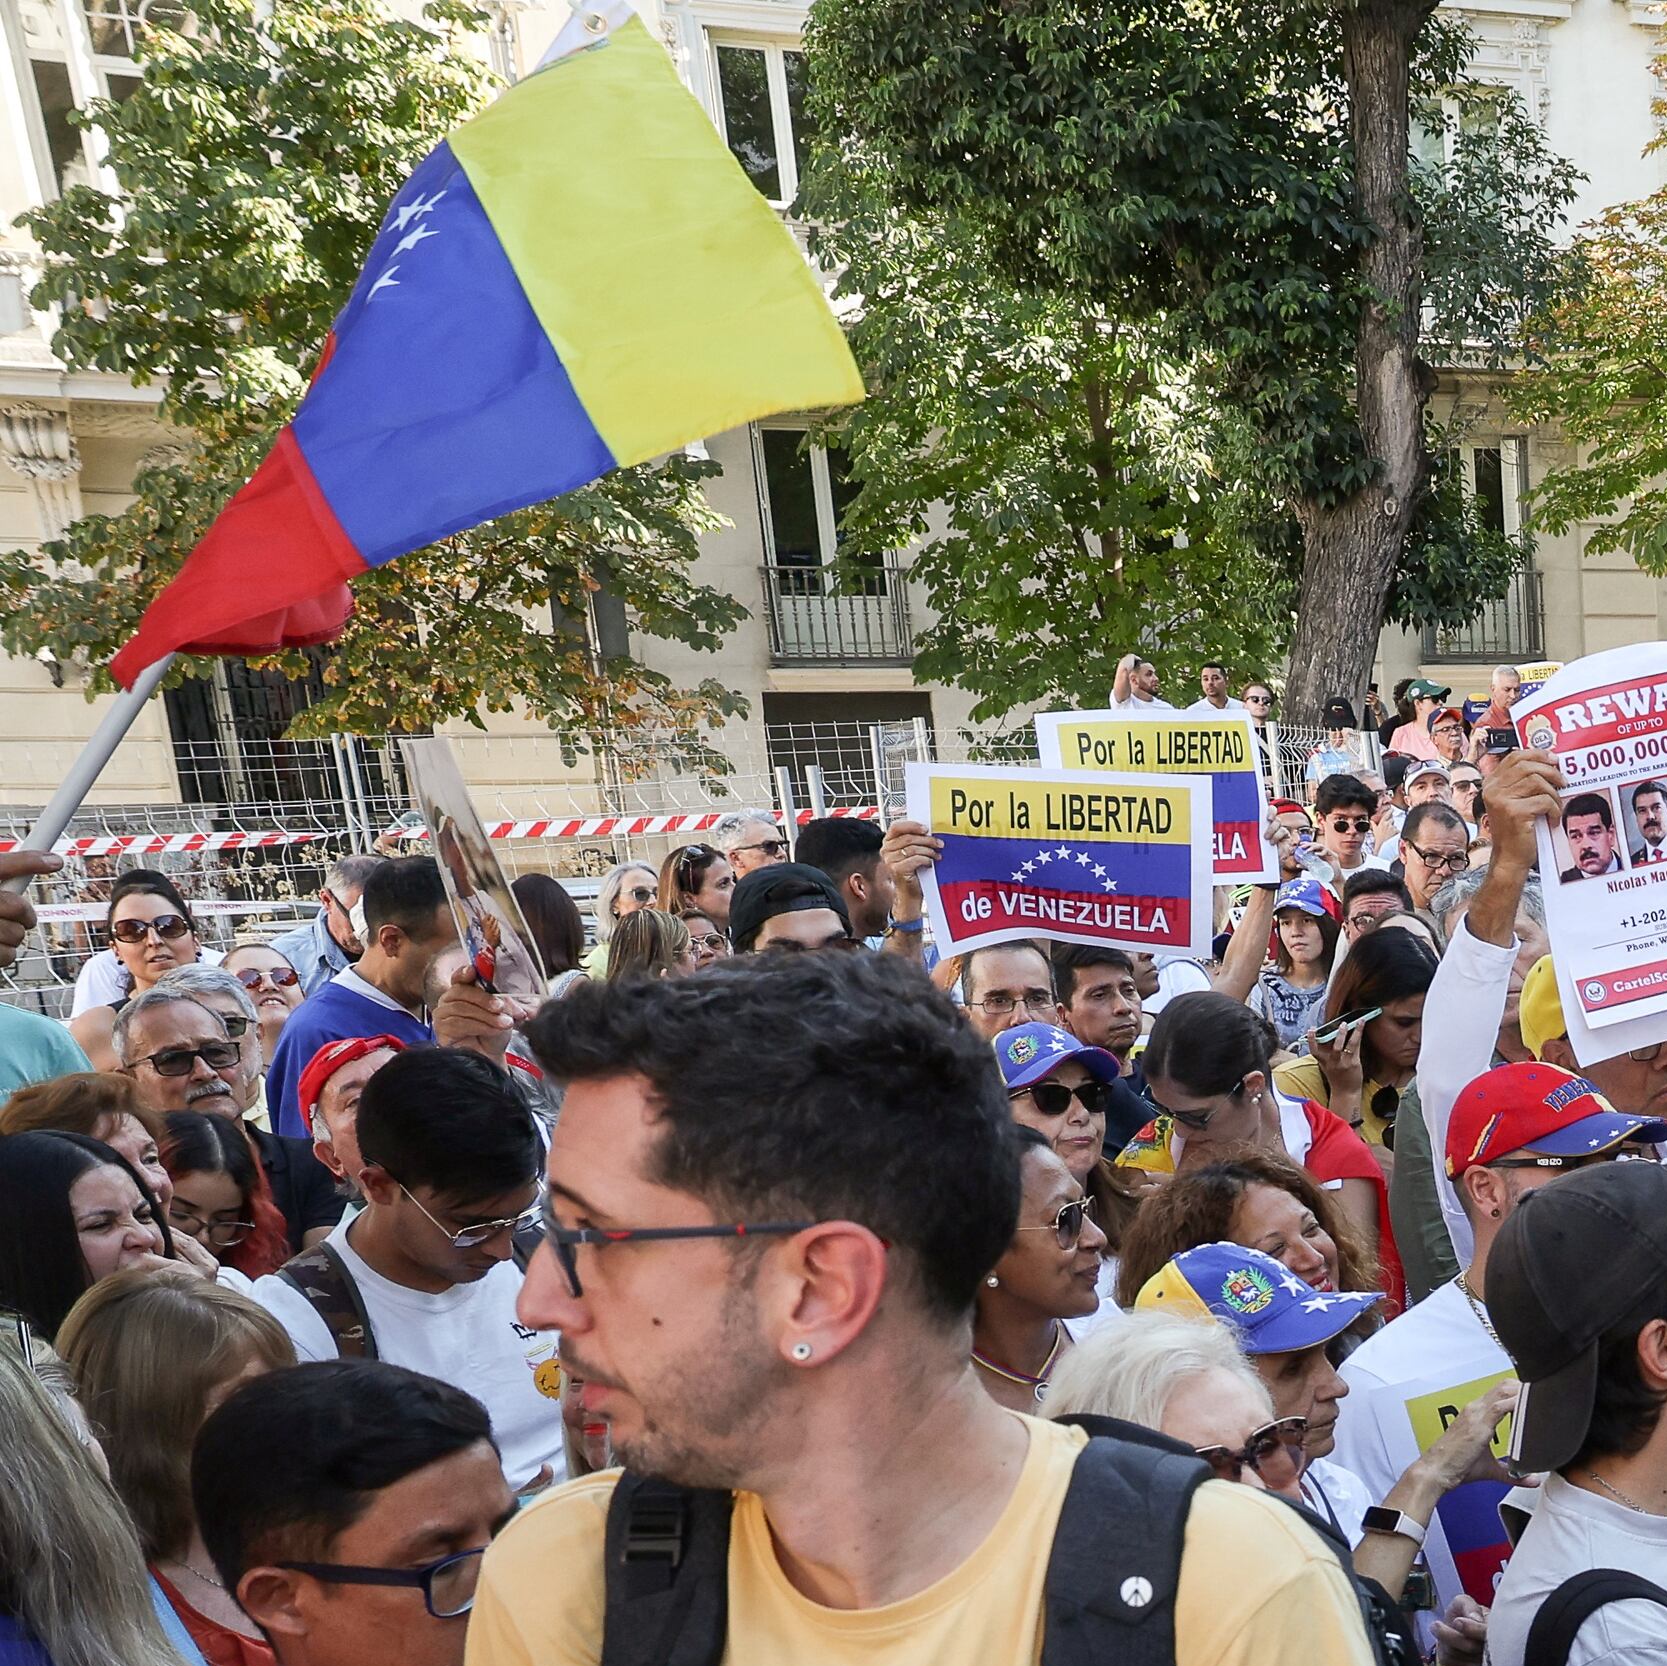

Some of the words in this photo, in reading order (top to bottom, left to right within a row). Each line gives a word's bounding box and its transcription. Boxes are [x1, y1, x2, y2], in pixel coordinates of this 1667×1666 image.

[1617, 723, 1631, 734] OF
[1633, 721, 1648, 731] UP
[1649, 717, 1664, 728] TO
[1077, 732, 1116, 765] Por
[1127, 731, 1145, 765] la
[1156, 730, 1244, 764] LIBERTAD
[1599, 771, 1629, 782] LEADING
[950, 789, 995, 829] Por
[1009, 791, 1030, 829] la
[1046, 792, 1173, 834] LIBERTAD
[960, 891, 992, 922] de
[998, 890, 1171, 934] VENEZUELA
[1626, 936, 1658, 952] Phone,
